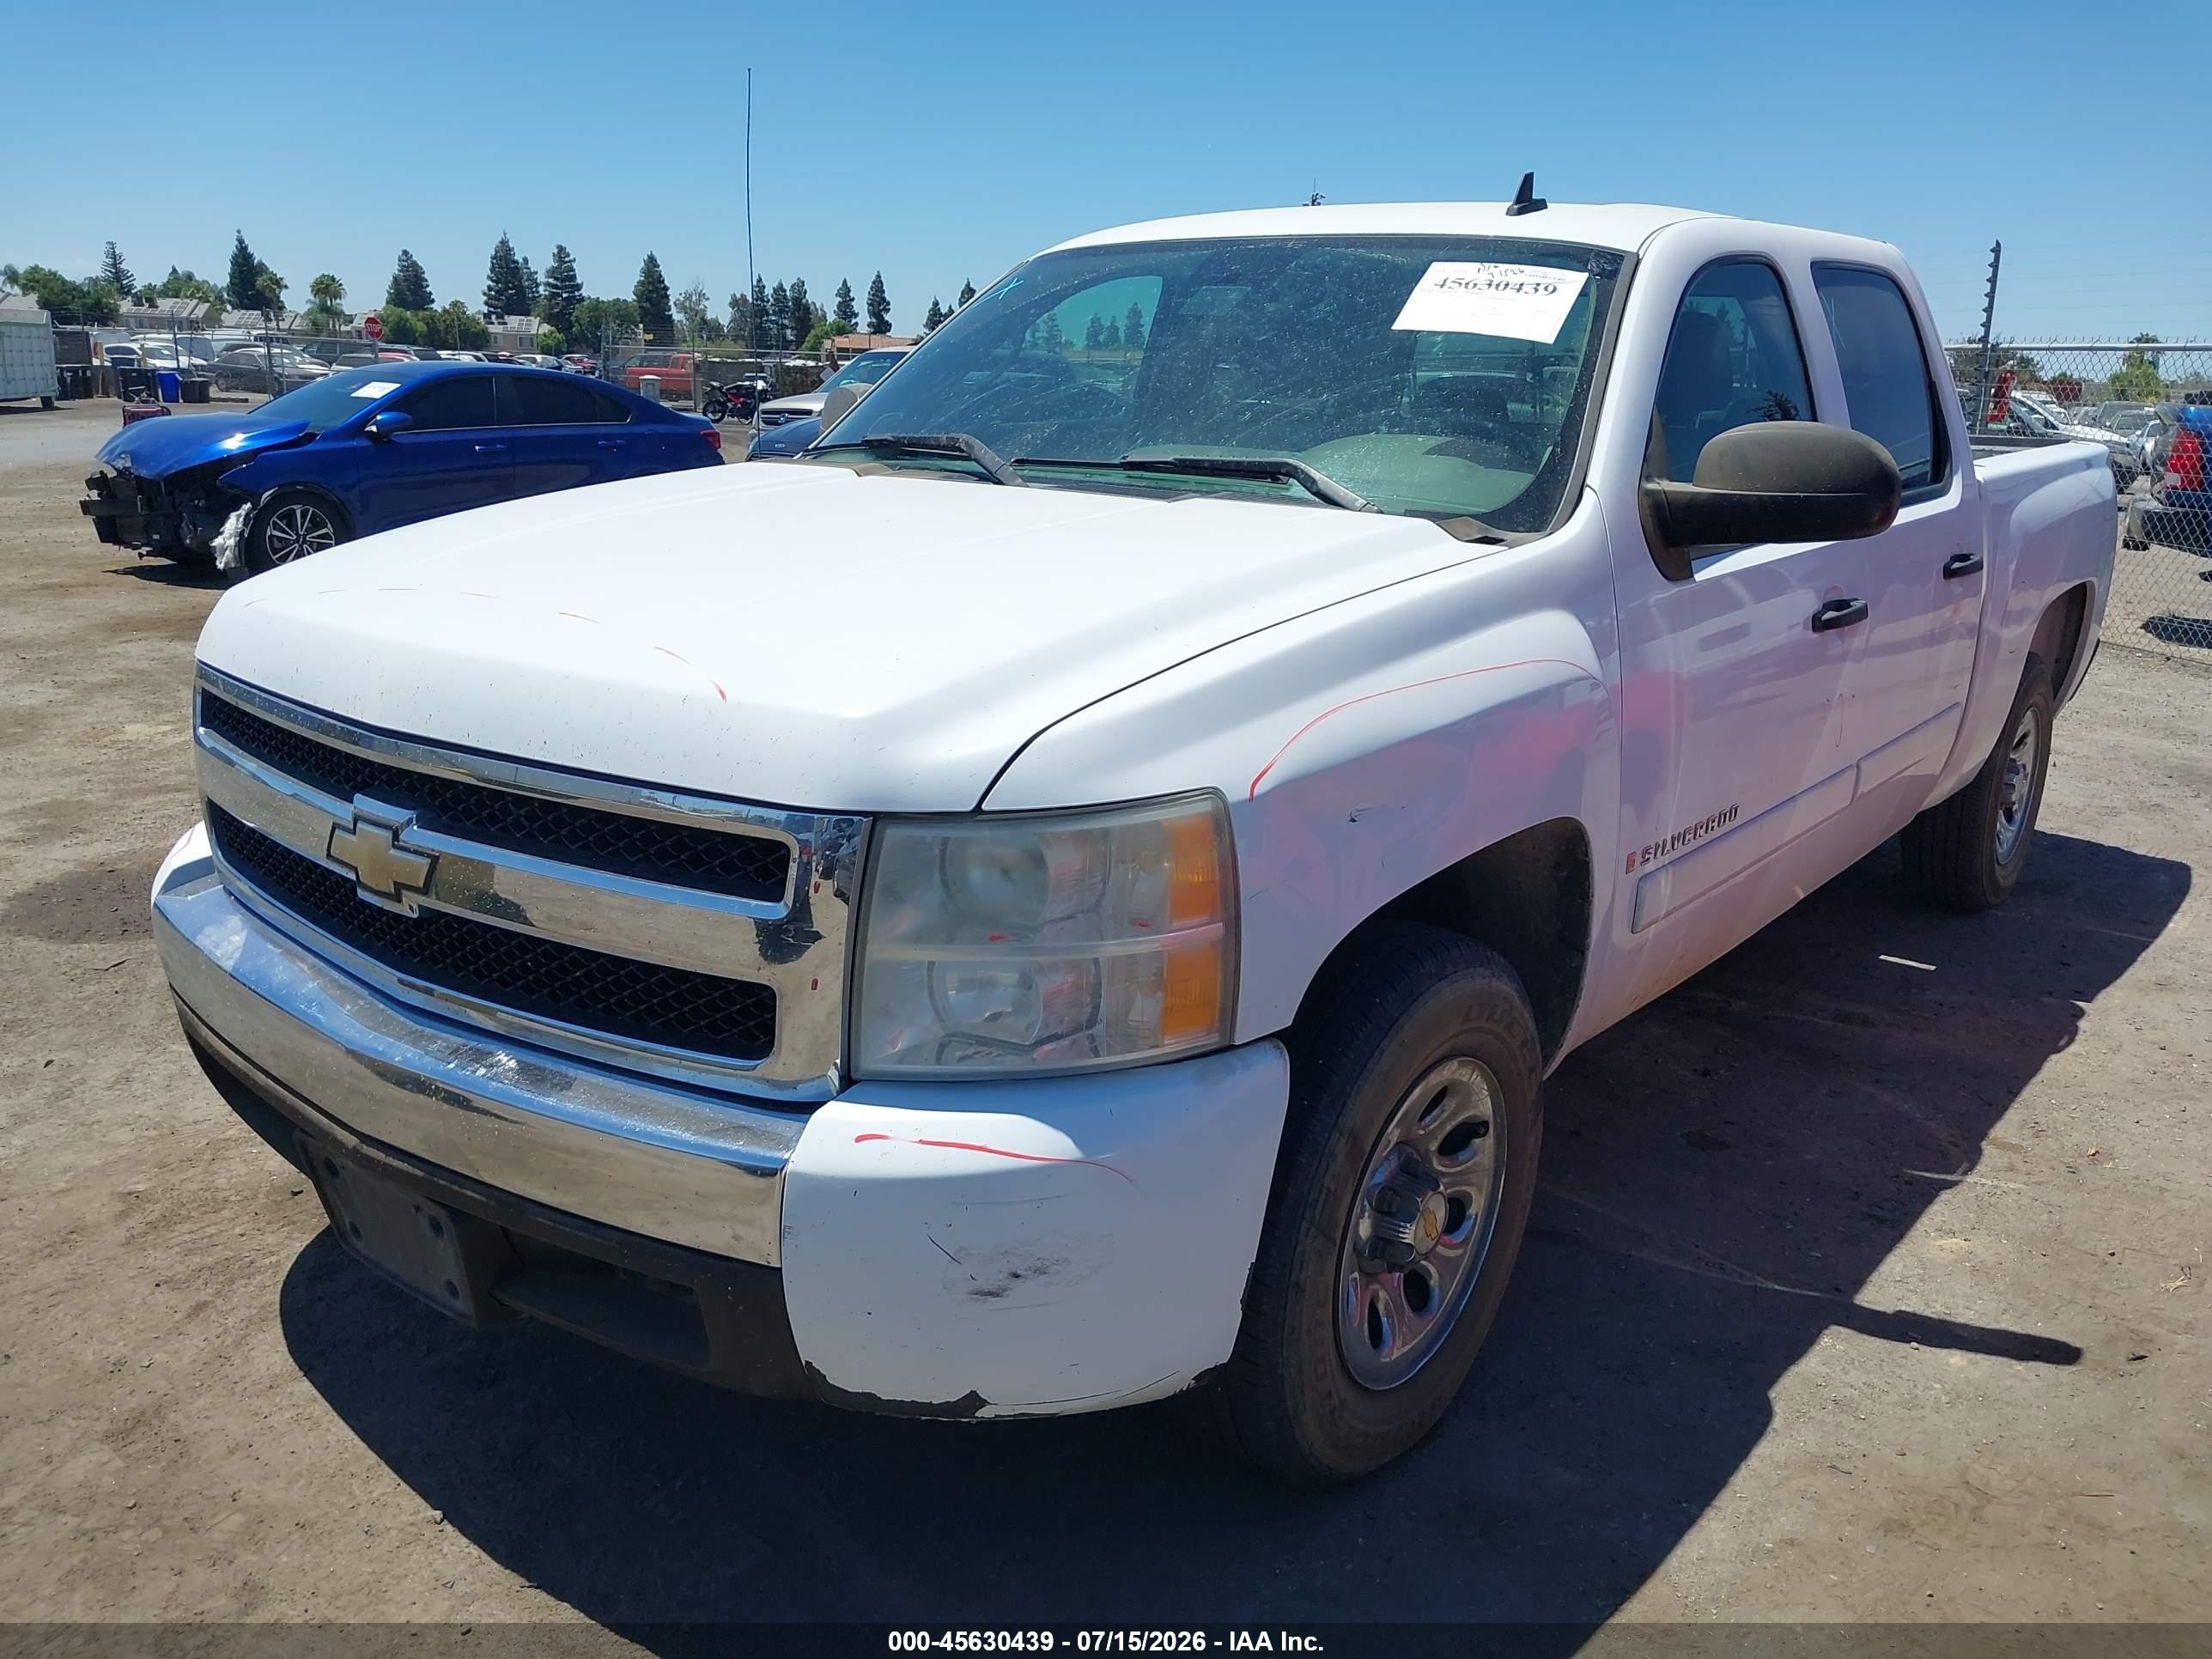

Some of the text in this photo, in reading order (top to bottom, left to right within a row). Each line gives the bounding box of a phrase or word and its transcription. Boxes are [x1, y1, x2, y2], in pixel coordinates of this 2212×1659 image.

[1433, 276, 1558, 295] 45630439
[366, 323, 381, 331] STOP
[1640, 803, 1740, 866] SILVERADO
